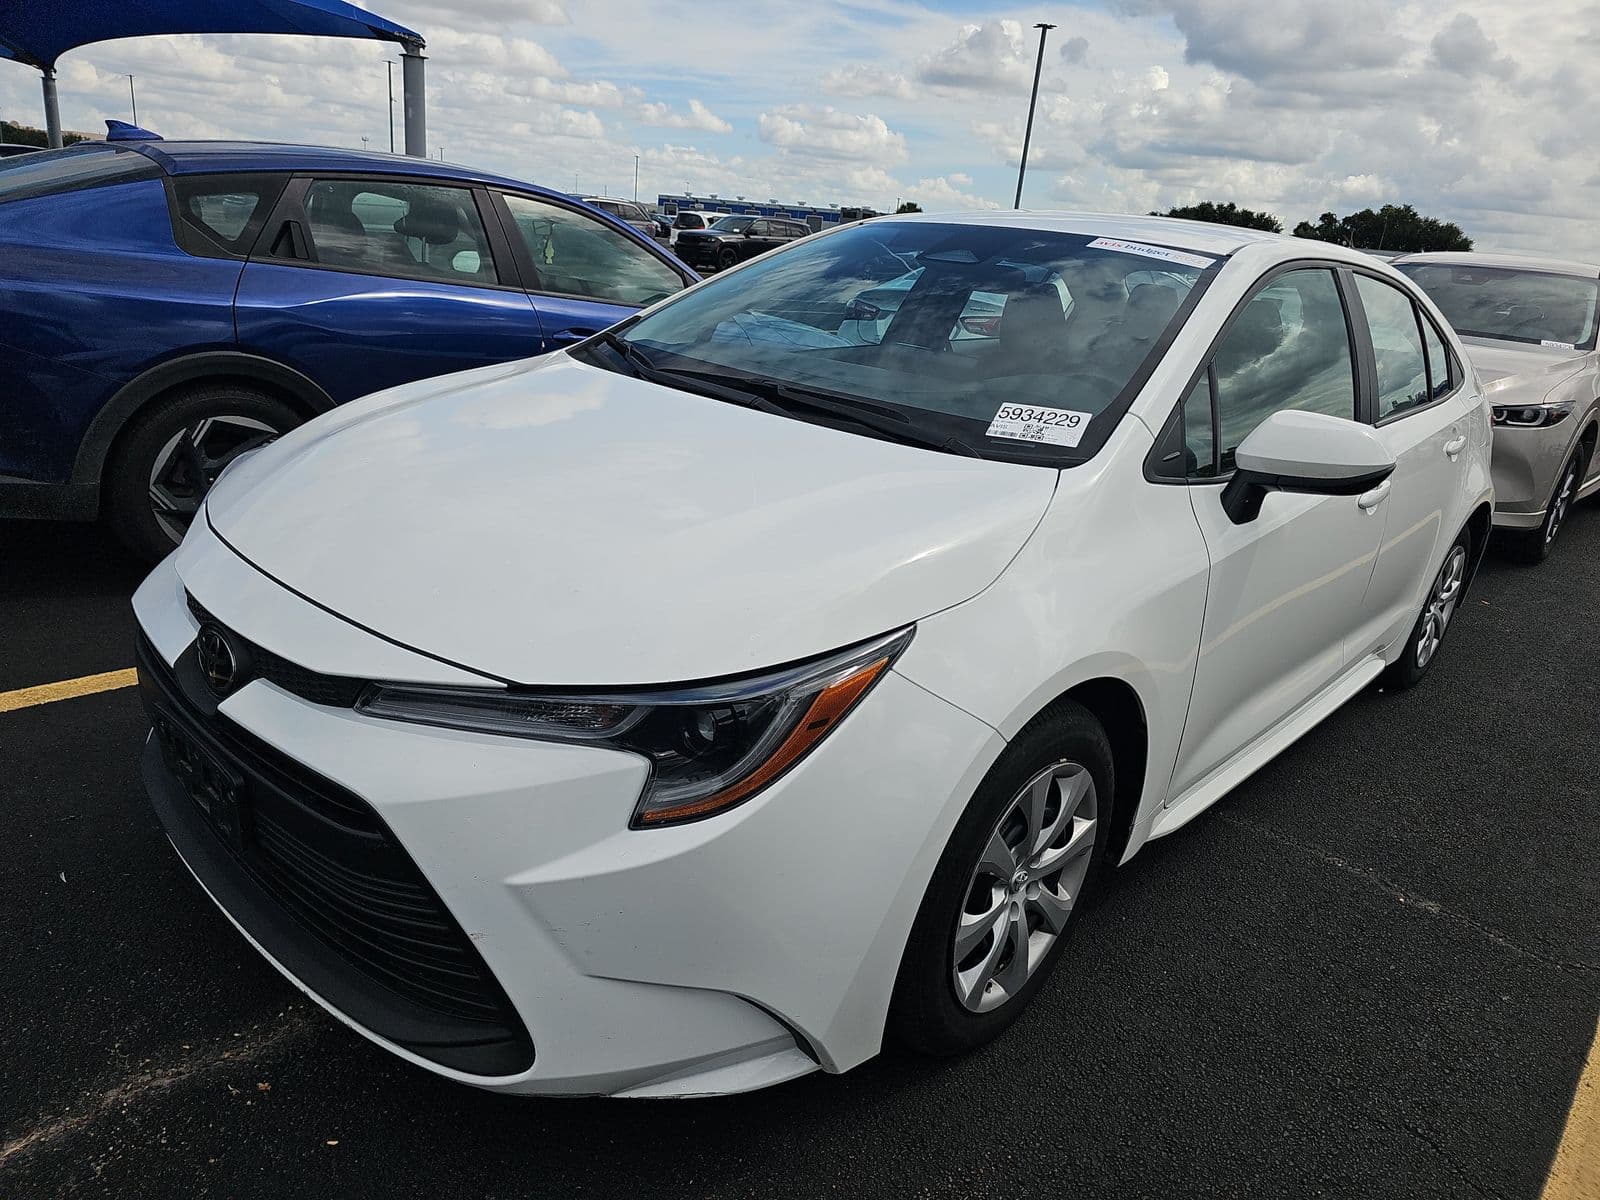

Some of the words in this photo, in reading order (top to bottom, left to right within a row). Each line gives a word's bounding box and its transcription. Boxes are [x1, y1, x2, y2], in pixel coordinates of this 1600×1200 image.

[1095, 241, 1122, 249] avis
[1124, 244, 1171, 257] budget
[998, 406, 1081, 428] 5934229
